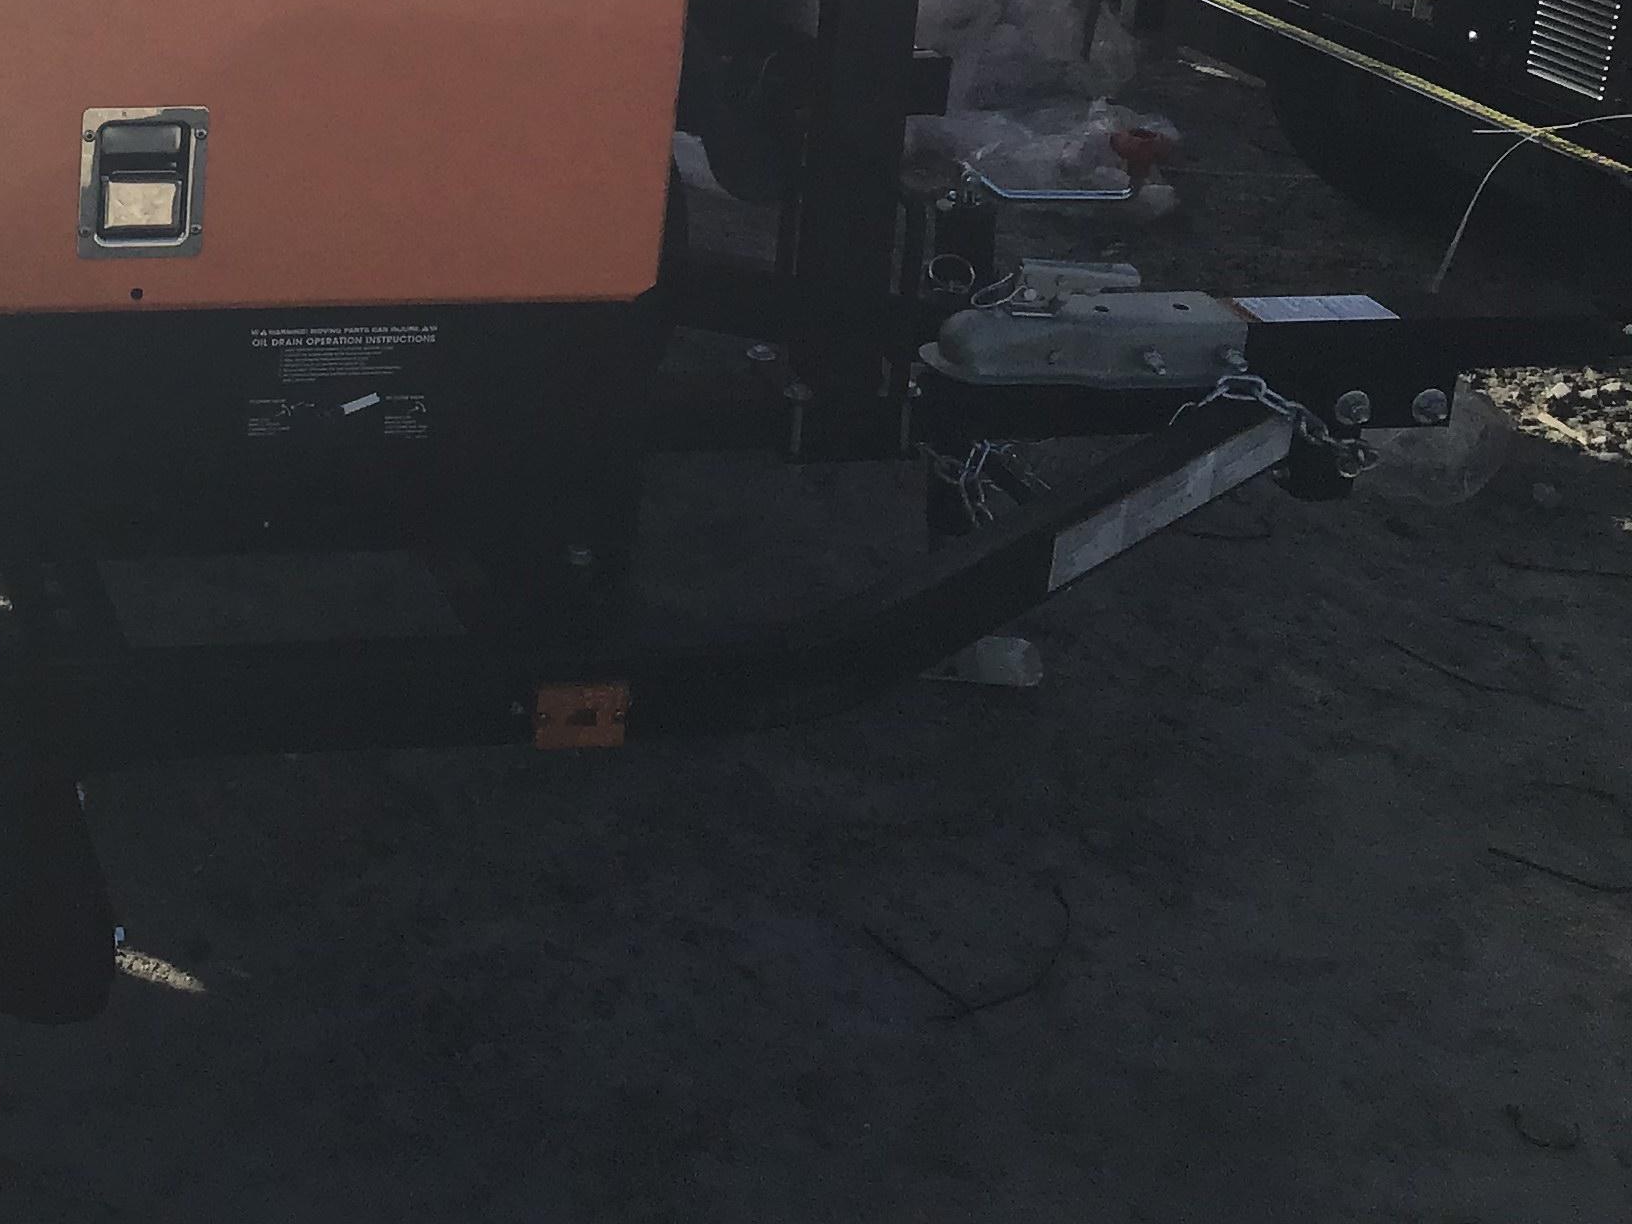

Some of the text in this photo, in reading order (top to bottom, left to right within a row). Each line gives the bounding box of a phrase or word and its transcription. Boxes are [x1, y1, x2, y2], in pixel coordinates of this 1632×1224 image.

[252, 334, 436, 348] OIL DRAIN OPERATION INSTRUCTIONS
